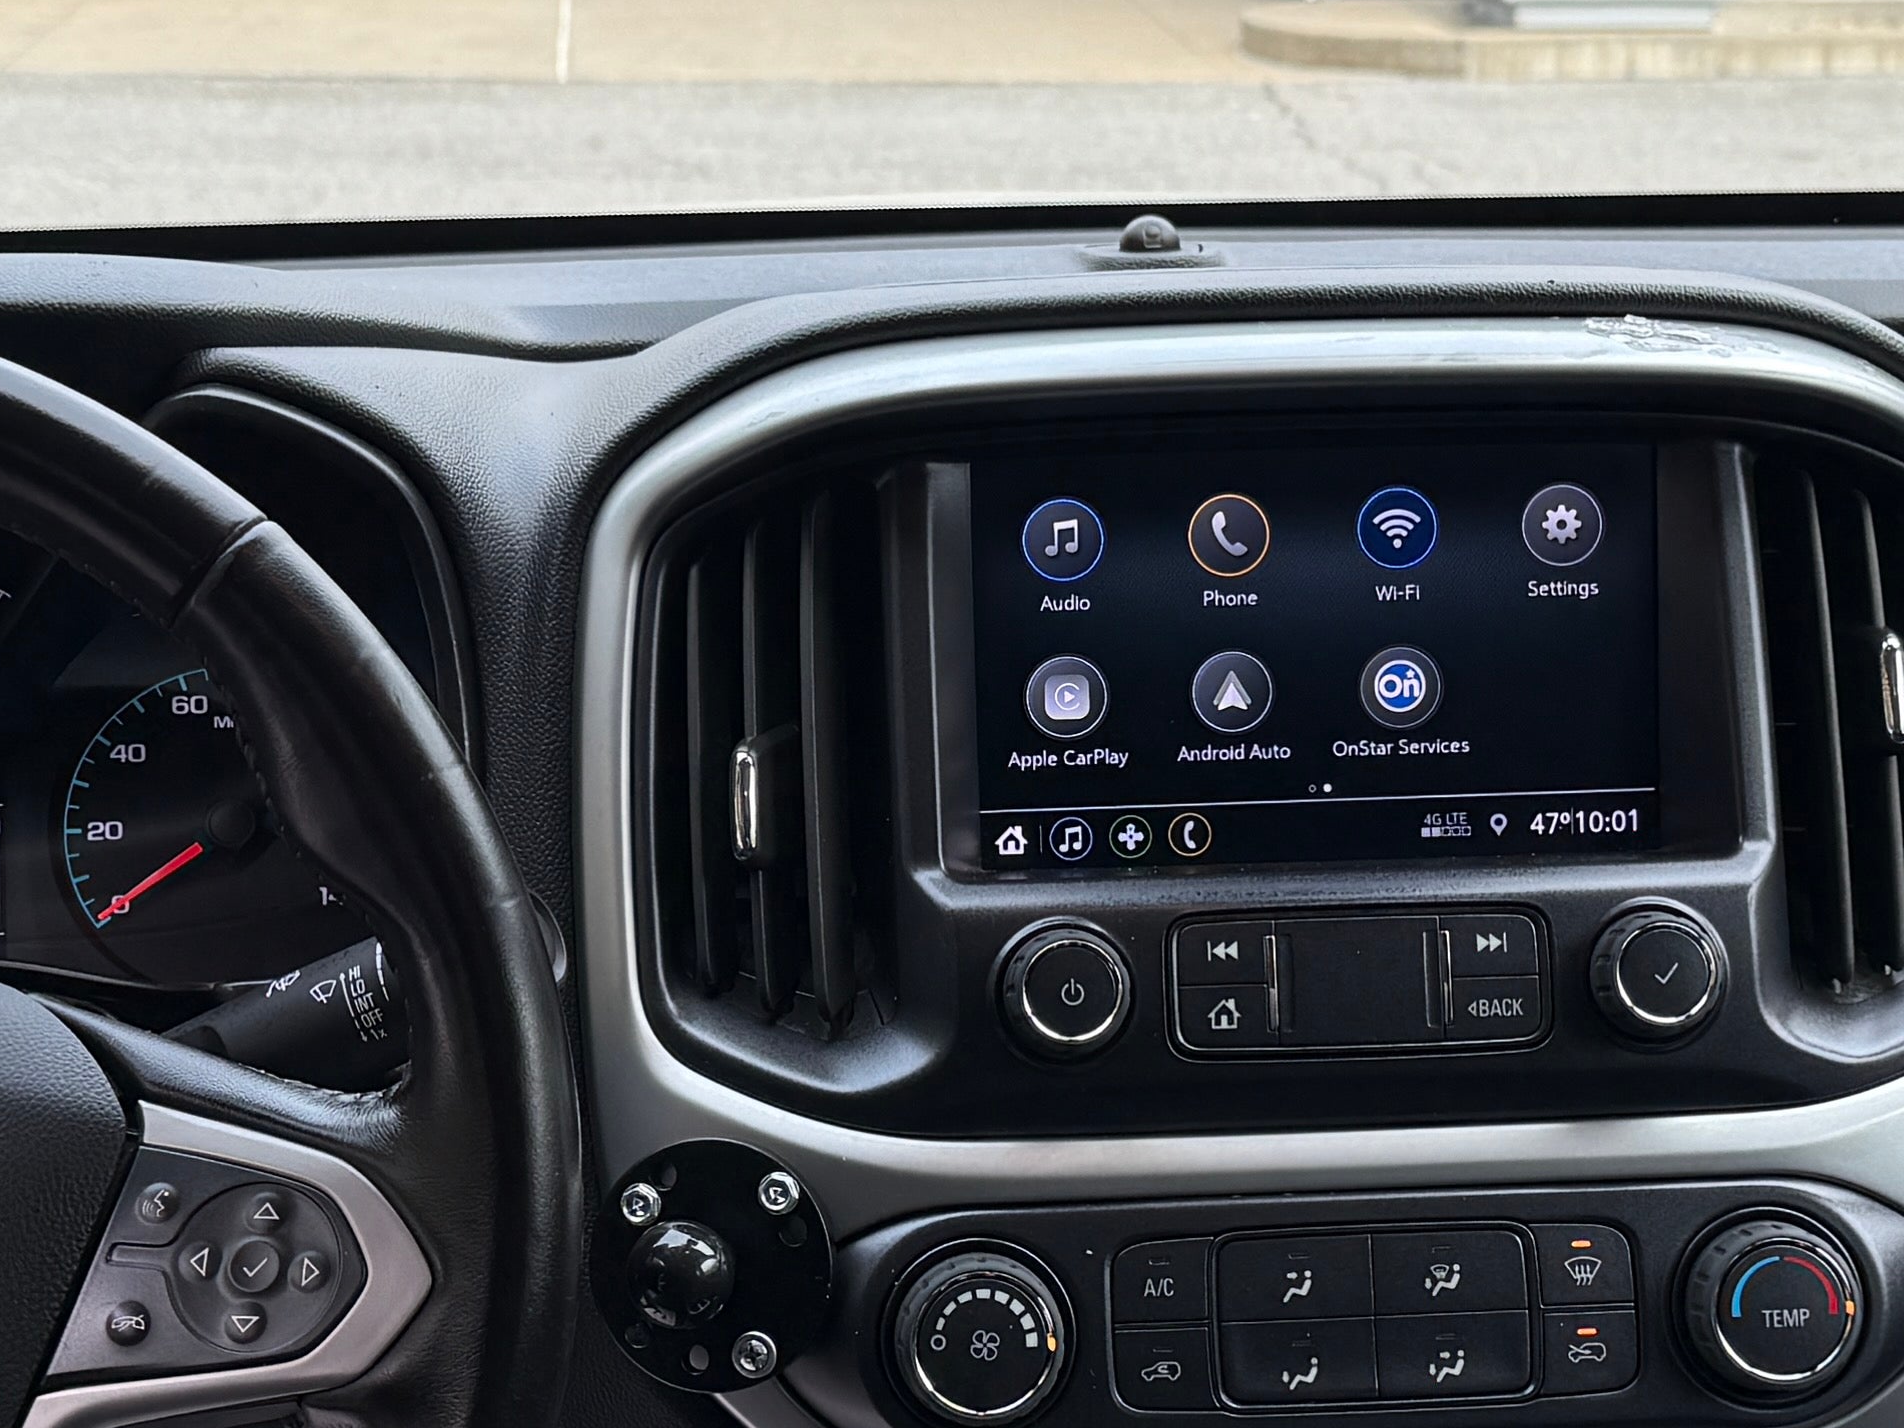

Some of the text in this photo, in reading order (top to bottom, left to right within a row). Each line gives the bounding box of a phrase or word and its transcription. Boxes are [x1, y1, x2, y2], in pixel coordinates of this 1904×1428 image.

[1202, 588, 1259, 609] Phone
[1375, 584, 1422, 602] Wi-Fi
[1527, 579, 1600, 601] Settings
[1040, 594, 1091, 613] Audio
[171, 694, 209, 716] 60
[108, 743, 147, 764] 40
[1177, 742, 1293, 763] Android Auto
[1331, 736, 1470, 757] OnStar Services
[1008, 746, 1130, 771] Apple CarPlay
[86, 820, 124, 842] 20
[1423, 813, 1442, 826] 4G
[1445, 812, 1468, 825] LTE
[1576, 808, 1639, 835] 10:01
[348, 965, 361, 981] HI
[351, 978, 366, 997] LO
[354, 992, 375, 1013] INT
[1477, 995, 1525, 1019] BACK
[361, 1008, 384, 1029] OFF
[1142, 1275, 1176, 1301] A/C
[1760, 1306, 1811, 1331] TEMP
